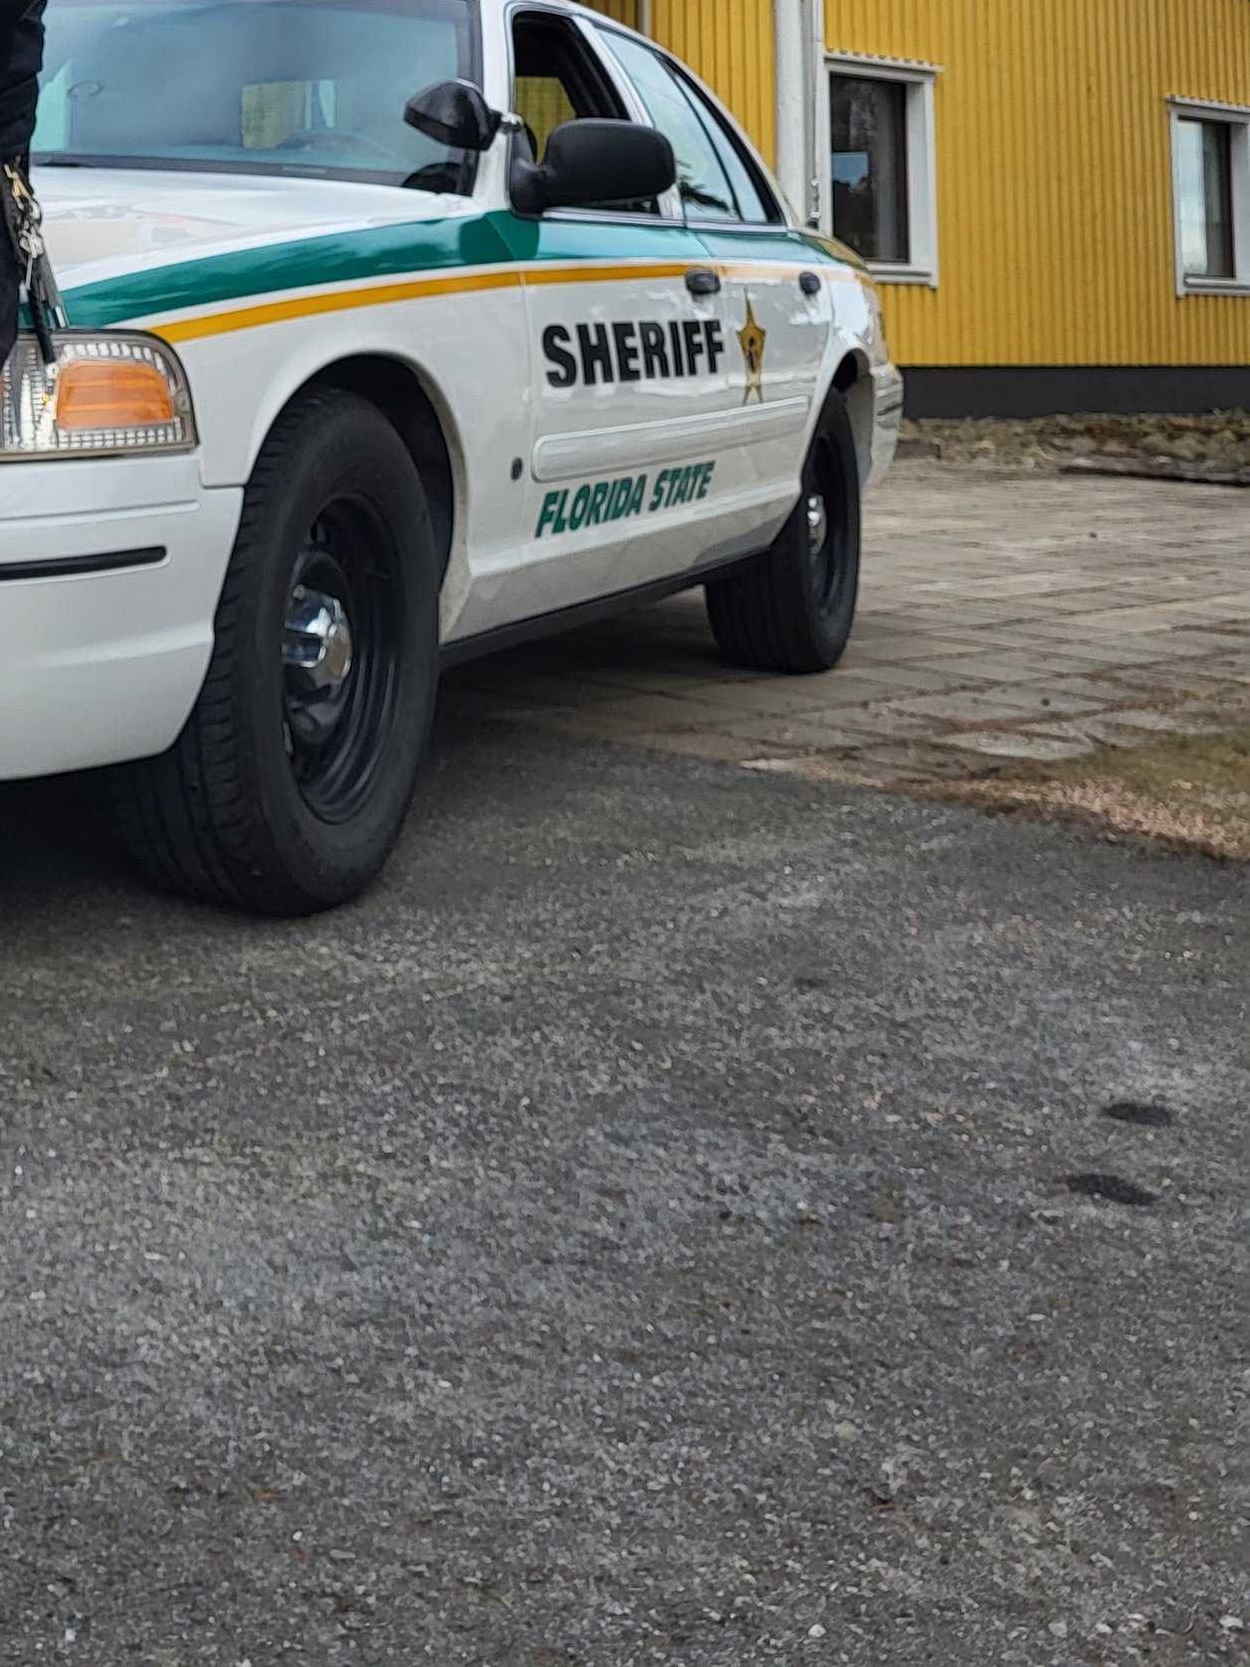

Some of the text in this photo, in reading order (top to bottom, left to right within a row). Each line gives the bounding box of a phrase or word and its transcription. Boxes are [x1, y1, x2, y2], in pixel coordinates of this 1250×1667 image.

[542, 320, 724, 388] SHERIFF
[535, 462, 715, 538] FLORIDA STATE
